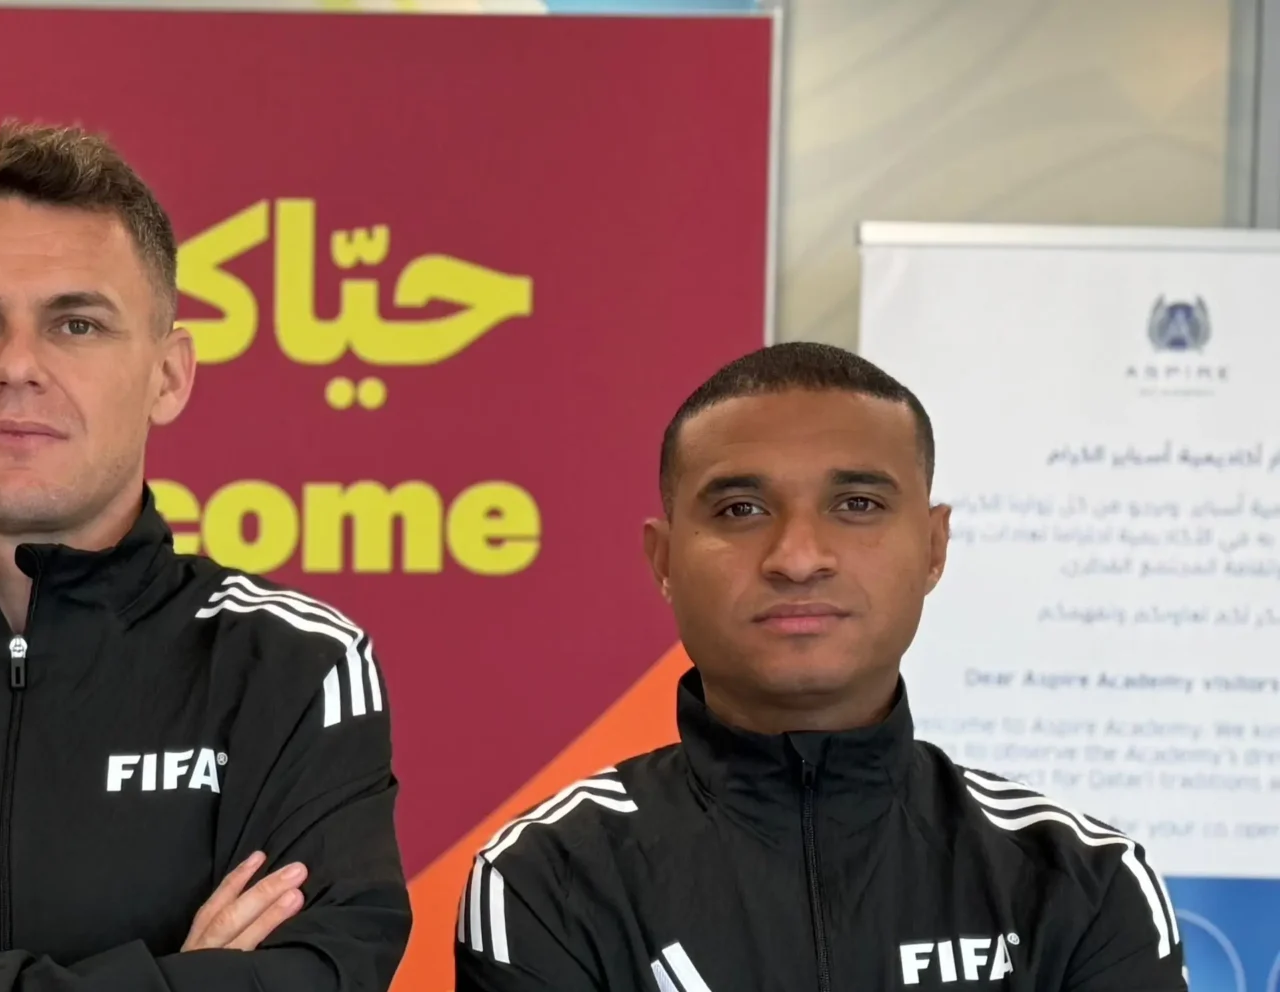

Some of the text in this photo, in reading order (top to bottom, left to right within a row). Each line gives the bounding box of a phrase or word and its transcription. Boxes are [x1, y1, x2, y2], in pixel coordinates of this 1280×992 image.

[966, 669, 1014, 687] Dear
[1024, 670, 1089, 690] Aspire
[1097, 672, 1193, 694] Academy
